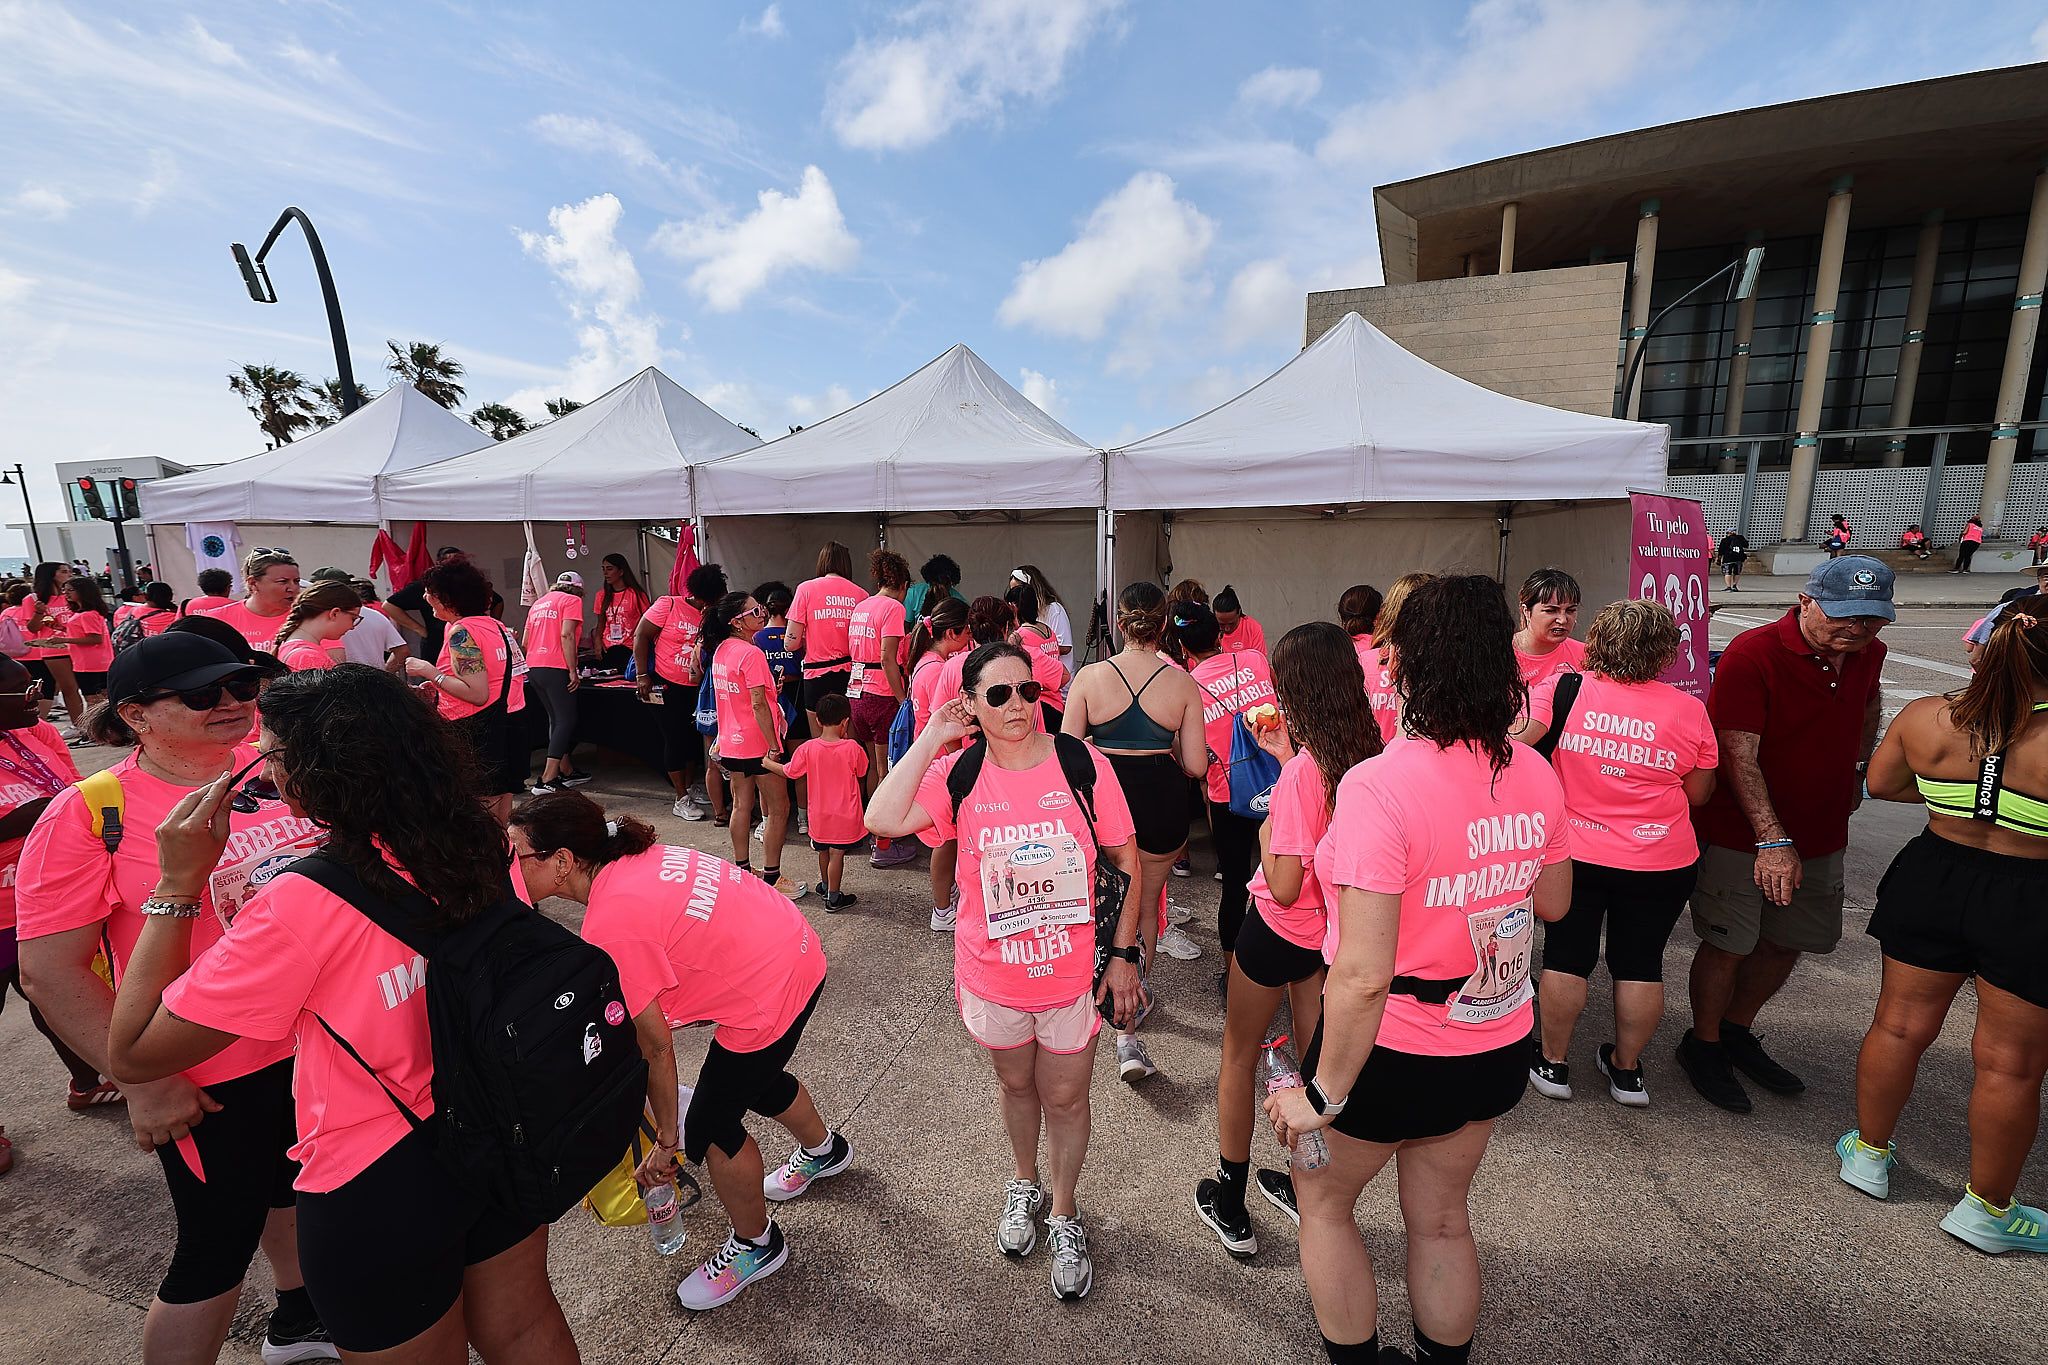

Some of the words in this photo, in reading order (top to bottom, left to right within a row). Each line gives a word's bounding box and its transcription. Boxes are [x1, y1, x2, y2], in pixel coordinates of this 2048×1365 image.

[1646, 512, 1663, 533] Tu
[1666, 516, 1689, 539] pelo
[1638, 545, 1659, 557] vale
[1660, 548, 1671, 558] un
[1672, 546, 1700, 559] tesoro
[825, 595, 856, 607] SOMOS
[814, 608, 852, 620] IMPARAB
[674, 653, 691, 667] MUJ
[765, 649, 794, 660] Irene
[1207, 667, 1256, 698] SOMOS
[1203, 680, 1275, 724] IMPARABLES
[1583, 710, 1656, 742] SOMOS
[1558, 731, 1678, 771] IMPARABLES
[1600, 764, 1626, 778] 2026
[1979, 755, 2001, 806] balance
[974, 801, 1010, 813] OYSHO
[1569, 818, 1609, 833] OYSHO
[218, 815, 321, 866] ARRERA
[1467, 811, 1546, 860] SOMOS
[987, 850, 1008, 859] SUMA
[1013, 850, 1052, 862] ASTURIANA
[659, 845, 691, 884] SOM
[216, 873, 246, 888] SUMA
[1016, 879, 1055, 897] 016
[1027, 896, 1046, 904] 4136
[1000, 917, 1030, 931] OYSHO
[1048, 912, 1079, 921] Santander
[1475, 921, 1496, 932] SUMA
[1000, 930, 1073, 965] MUJER
[1026, 963, 1054, 979] 2026
[1499, 951, 1524, 981] 016
[1465, 1006, 1501, 1018] OYSHO
